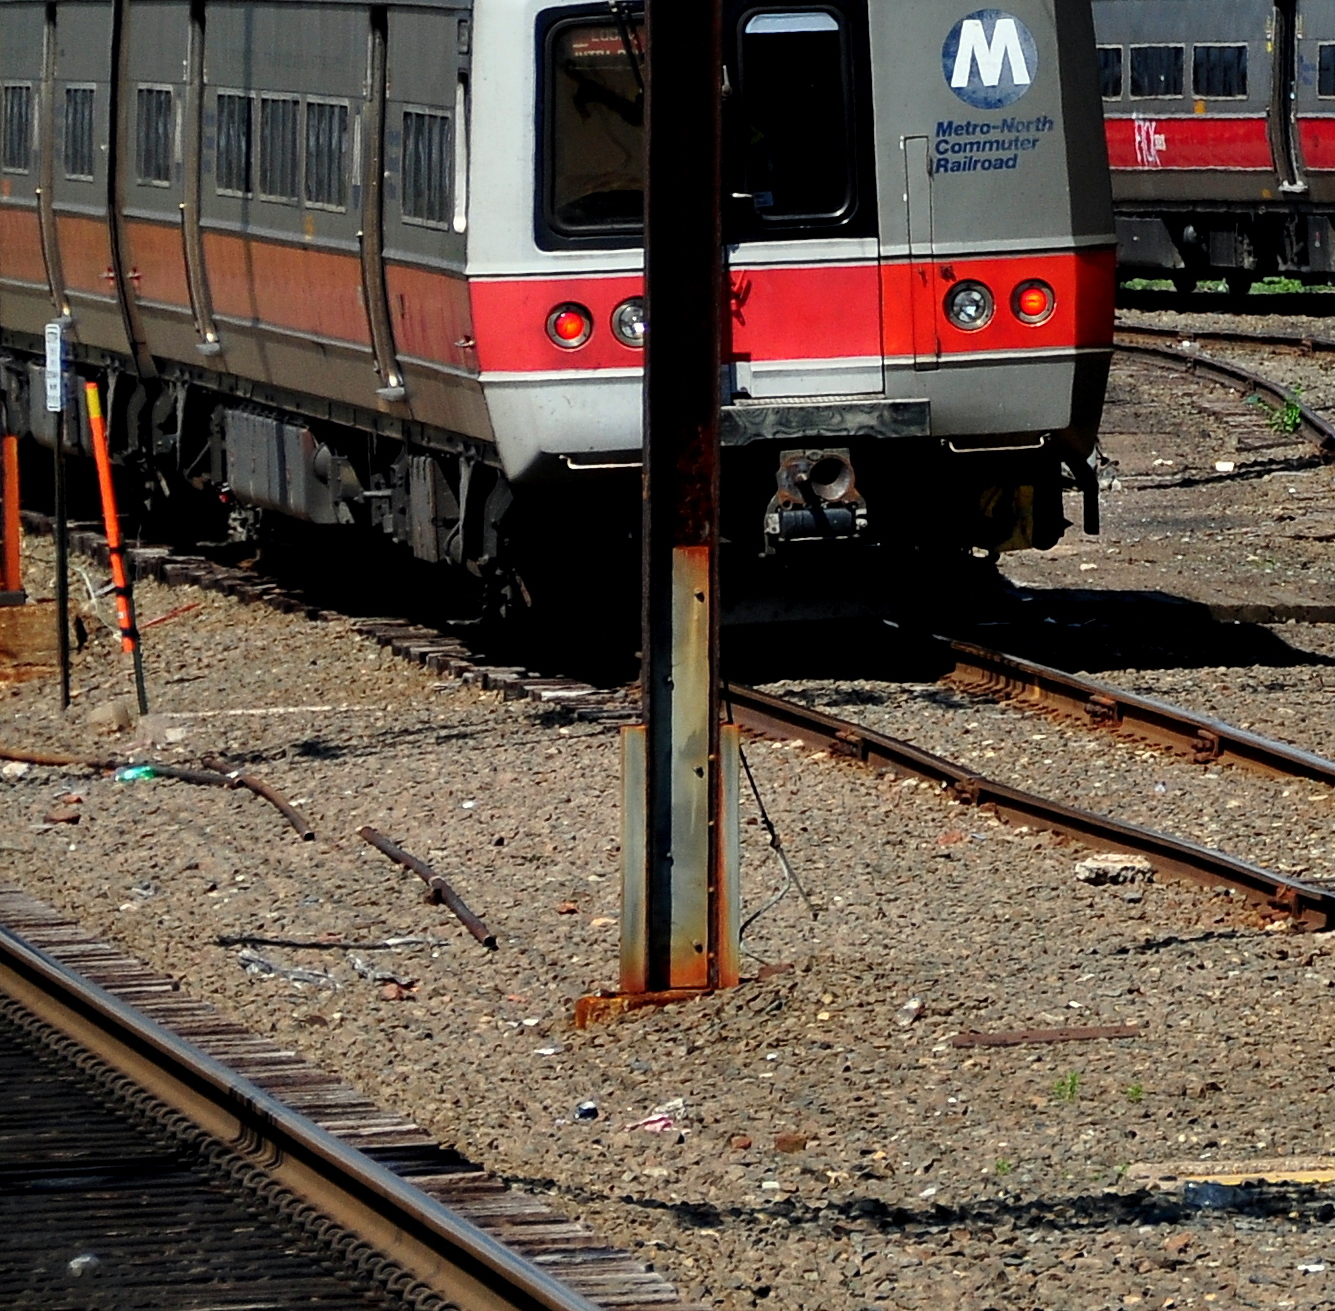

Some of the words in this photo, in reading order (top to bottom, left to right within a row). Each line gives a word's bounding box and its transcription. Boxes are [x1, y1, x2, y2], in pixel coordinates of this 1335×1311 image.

[951, 19, 1031, 88] M
[935, 116, 1054, 138] Metro-North
[935, 137, 1040, 156] Commuter
[934, 154, 1019, 174] Railroad
